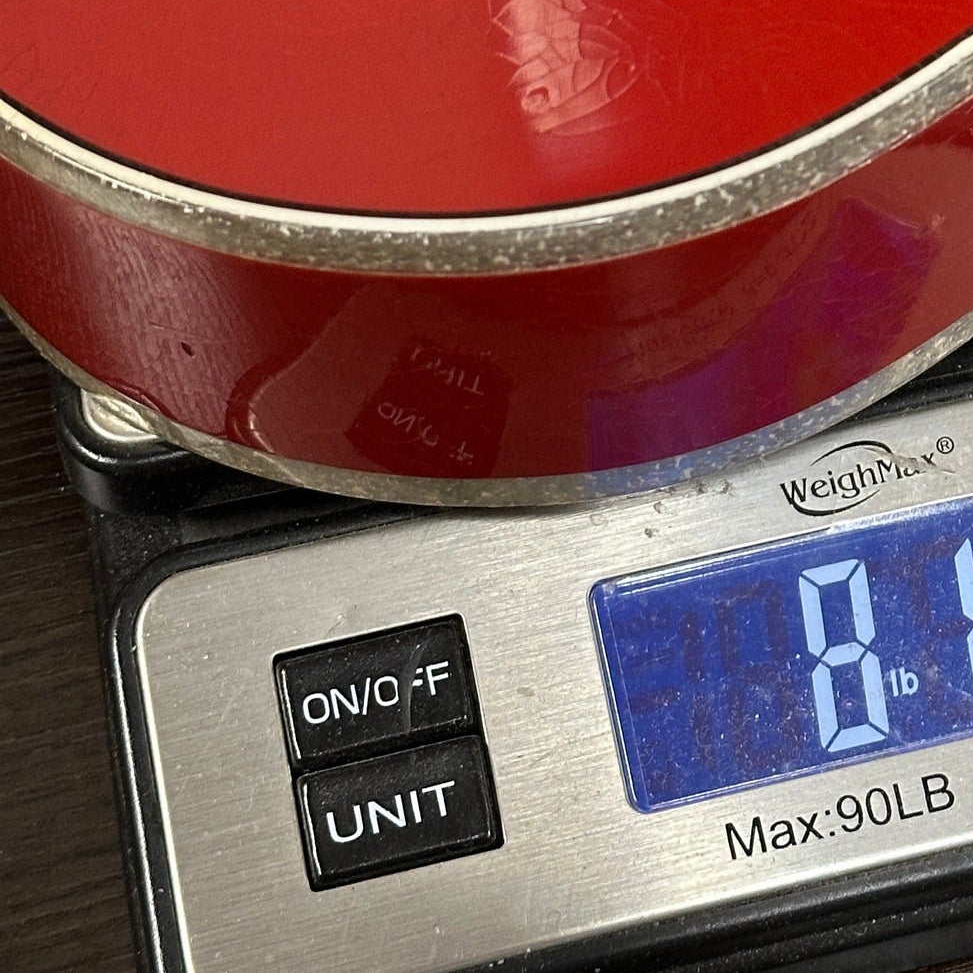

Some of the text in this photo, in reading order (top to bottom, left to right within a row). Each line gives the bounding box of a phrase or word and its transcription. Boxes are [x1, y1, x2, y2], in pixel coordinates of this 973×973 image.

[302, 661, 450, 725] ON/OF
[800, 558, 889, 753] 8
[891, 667, 919, 698] lb
[326, 780, 455, 843] UNIT
[725, 772, 955, 861] Max:90LB
